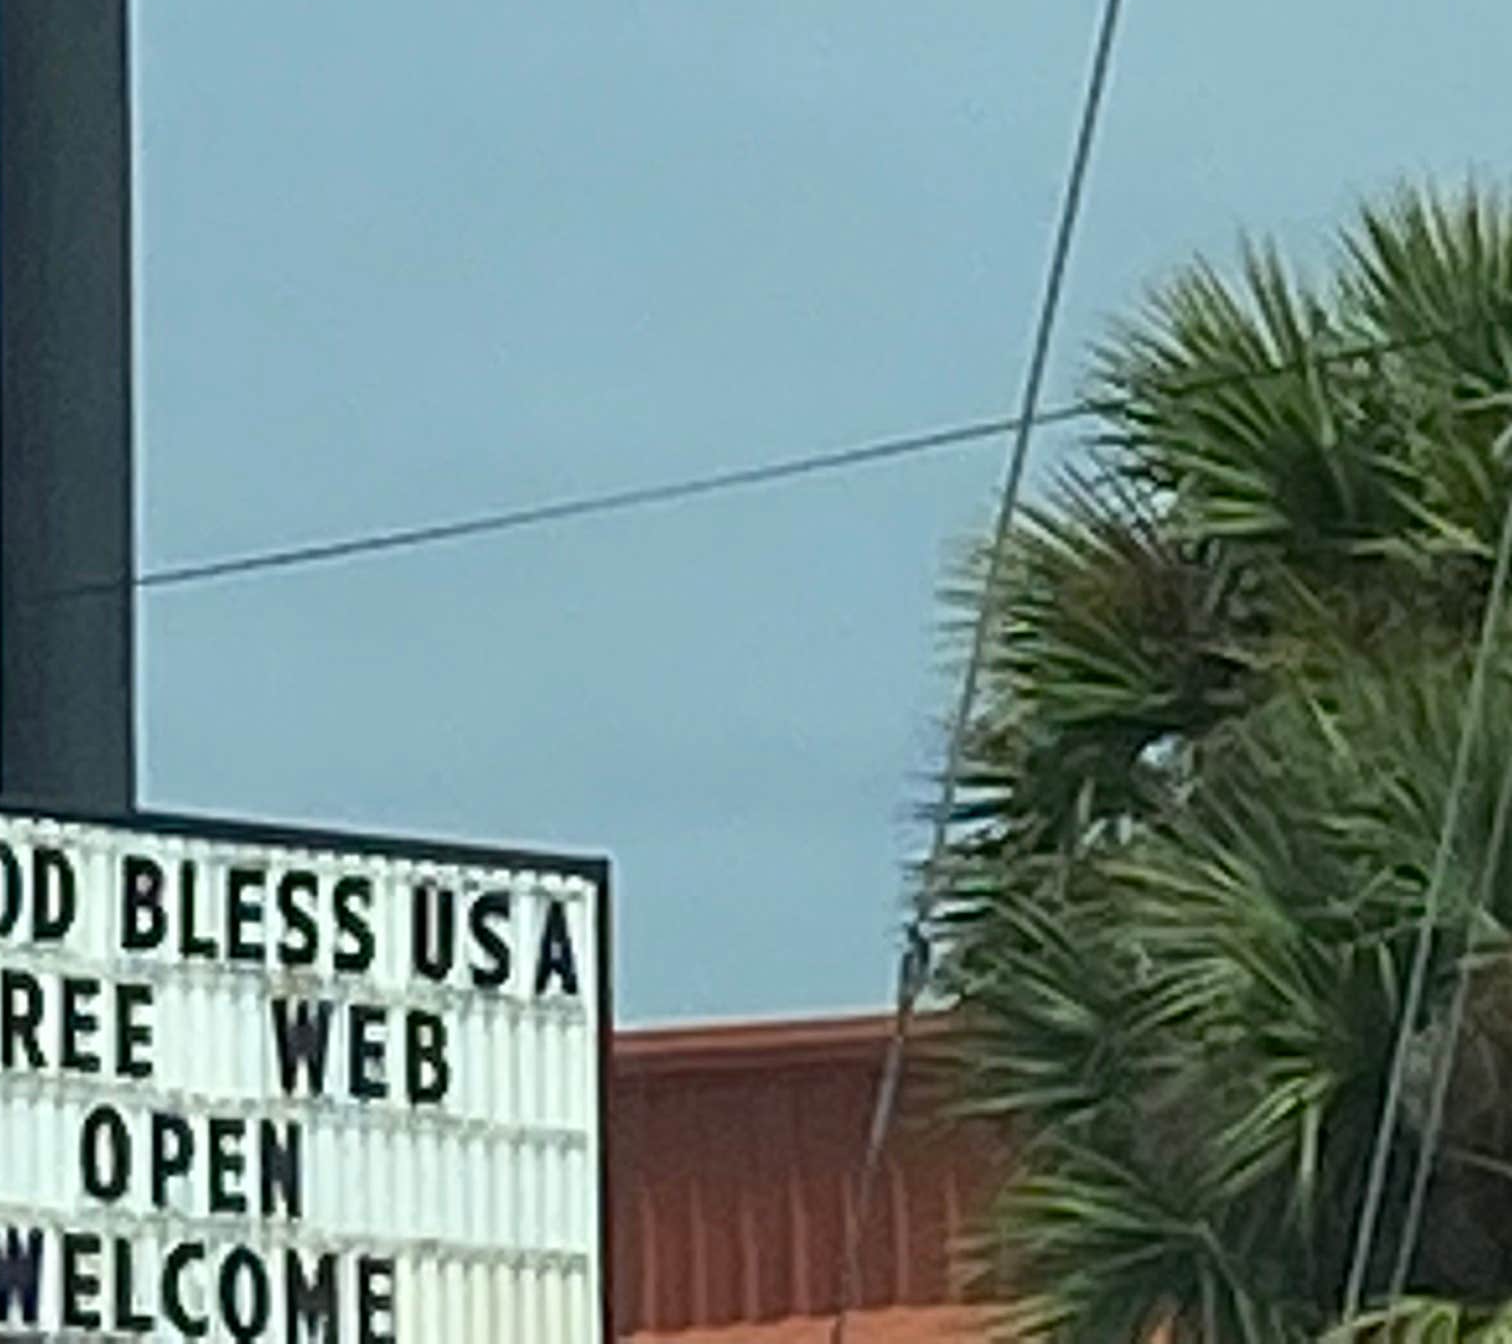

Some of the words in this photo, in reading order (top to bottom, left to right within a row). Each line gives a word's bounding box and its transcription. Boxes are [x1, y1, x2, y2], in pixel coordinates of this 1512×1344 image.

[120, 855, 376, 974] BLESS
[411, 878, 581, 996] USA
[271, 996, 451, 1105] WEB
[82, 1103, 304, 1218] OPEN
